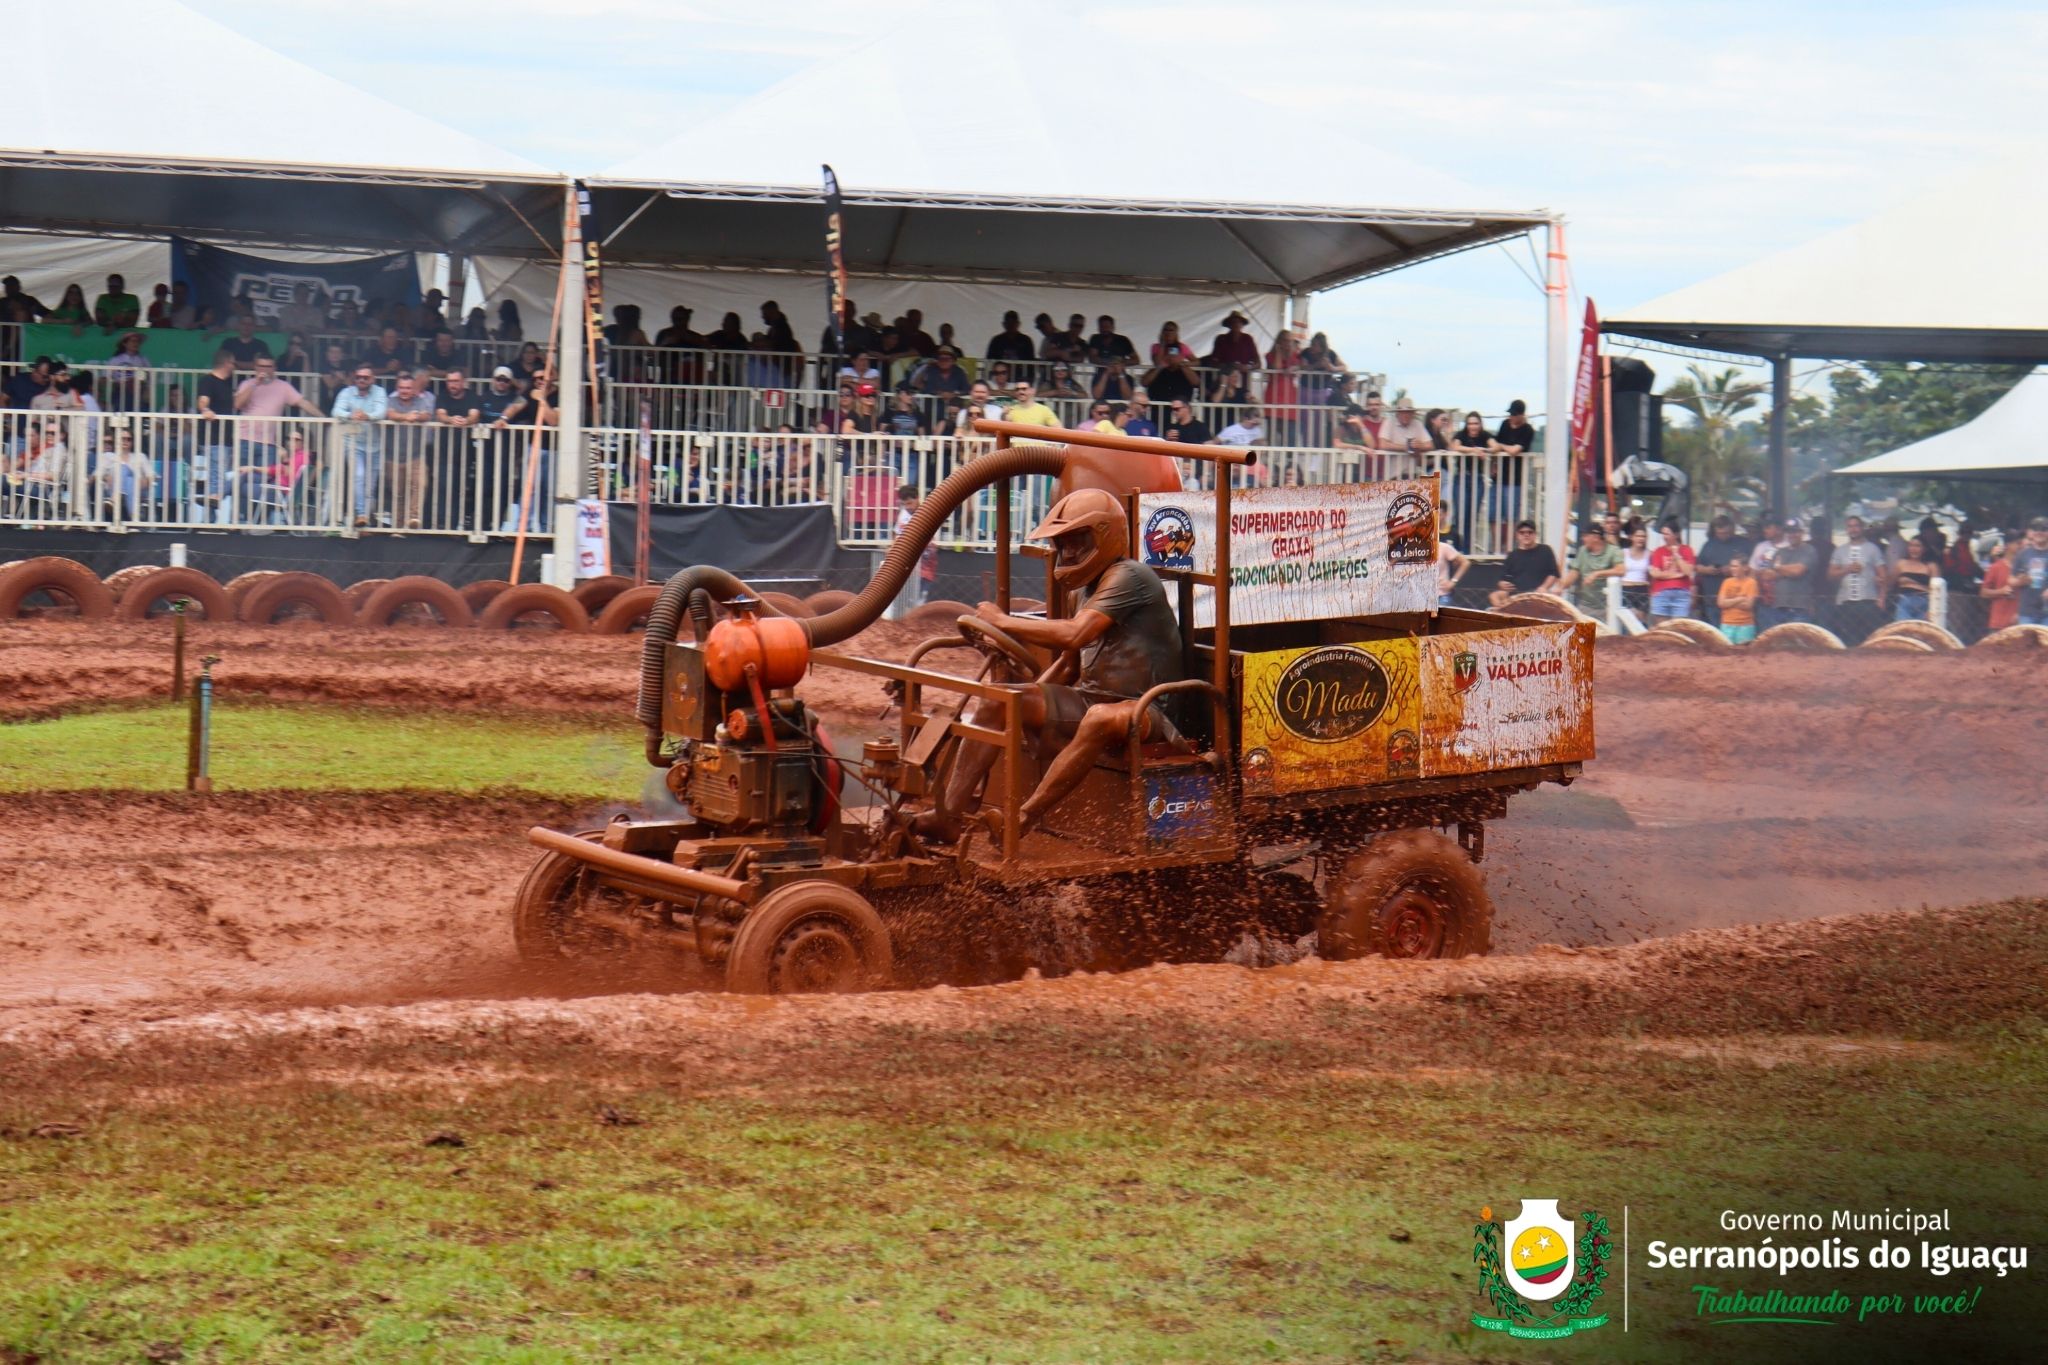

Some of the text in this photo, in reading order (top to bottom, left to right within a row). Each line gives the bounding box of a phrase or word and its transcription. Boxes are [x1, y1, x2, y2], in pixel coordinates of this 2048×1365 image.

[1231, 508, 1346, 535] SUPERMERCADO DO
[1307, 556, 1370, 583] CAMPEÕES
[1344, 651, 1376, 671] Familiar
[1486, 650, 1563, 664] TRANSPORTES
[1487, 658, 1563, 682] VALDACIR
[1286, 678, 1378, 720] Madu
[1423, 713, 1438, 721] Não
